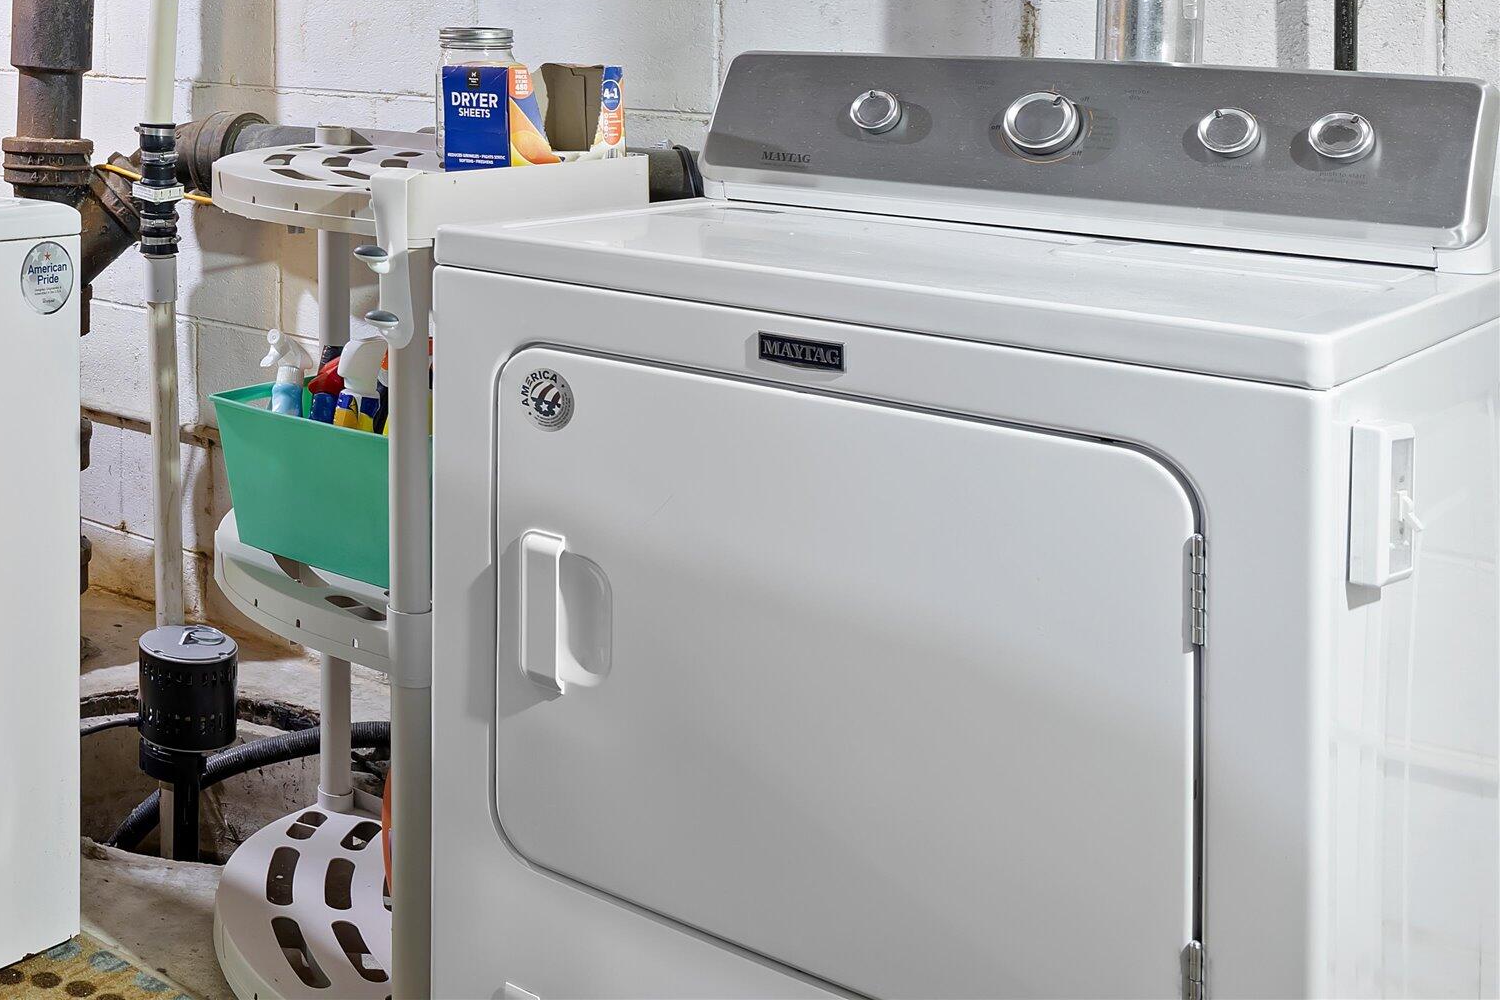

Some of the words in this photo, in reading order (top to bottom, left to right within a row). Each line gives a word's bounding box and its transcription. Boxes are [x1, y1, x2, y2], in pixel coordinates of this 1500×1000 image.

[451, 91, 498, 108] DRYER
[458, 107, 491, 118] SHEETS
[761, 151, 811, 163] MAYTAG
[27, 262, 68, 275] American
[37, 274, 60, 286] Pride
[762, 338, 841, 365] MAYTAG
[520, 370, 558, 407] AMERICA
